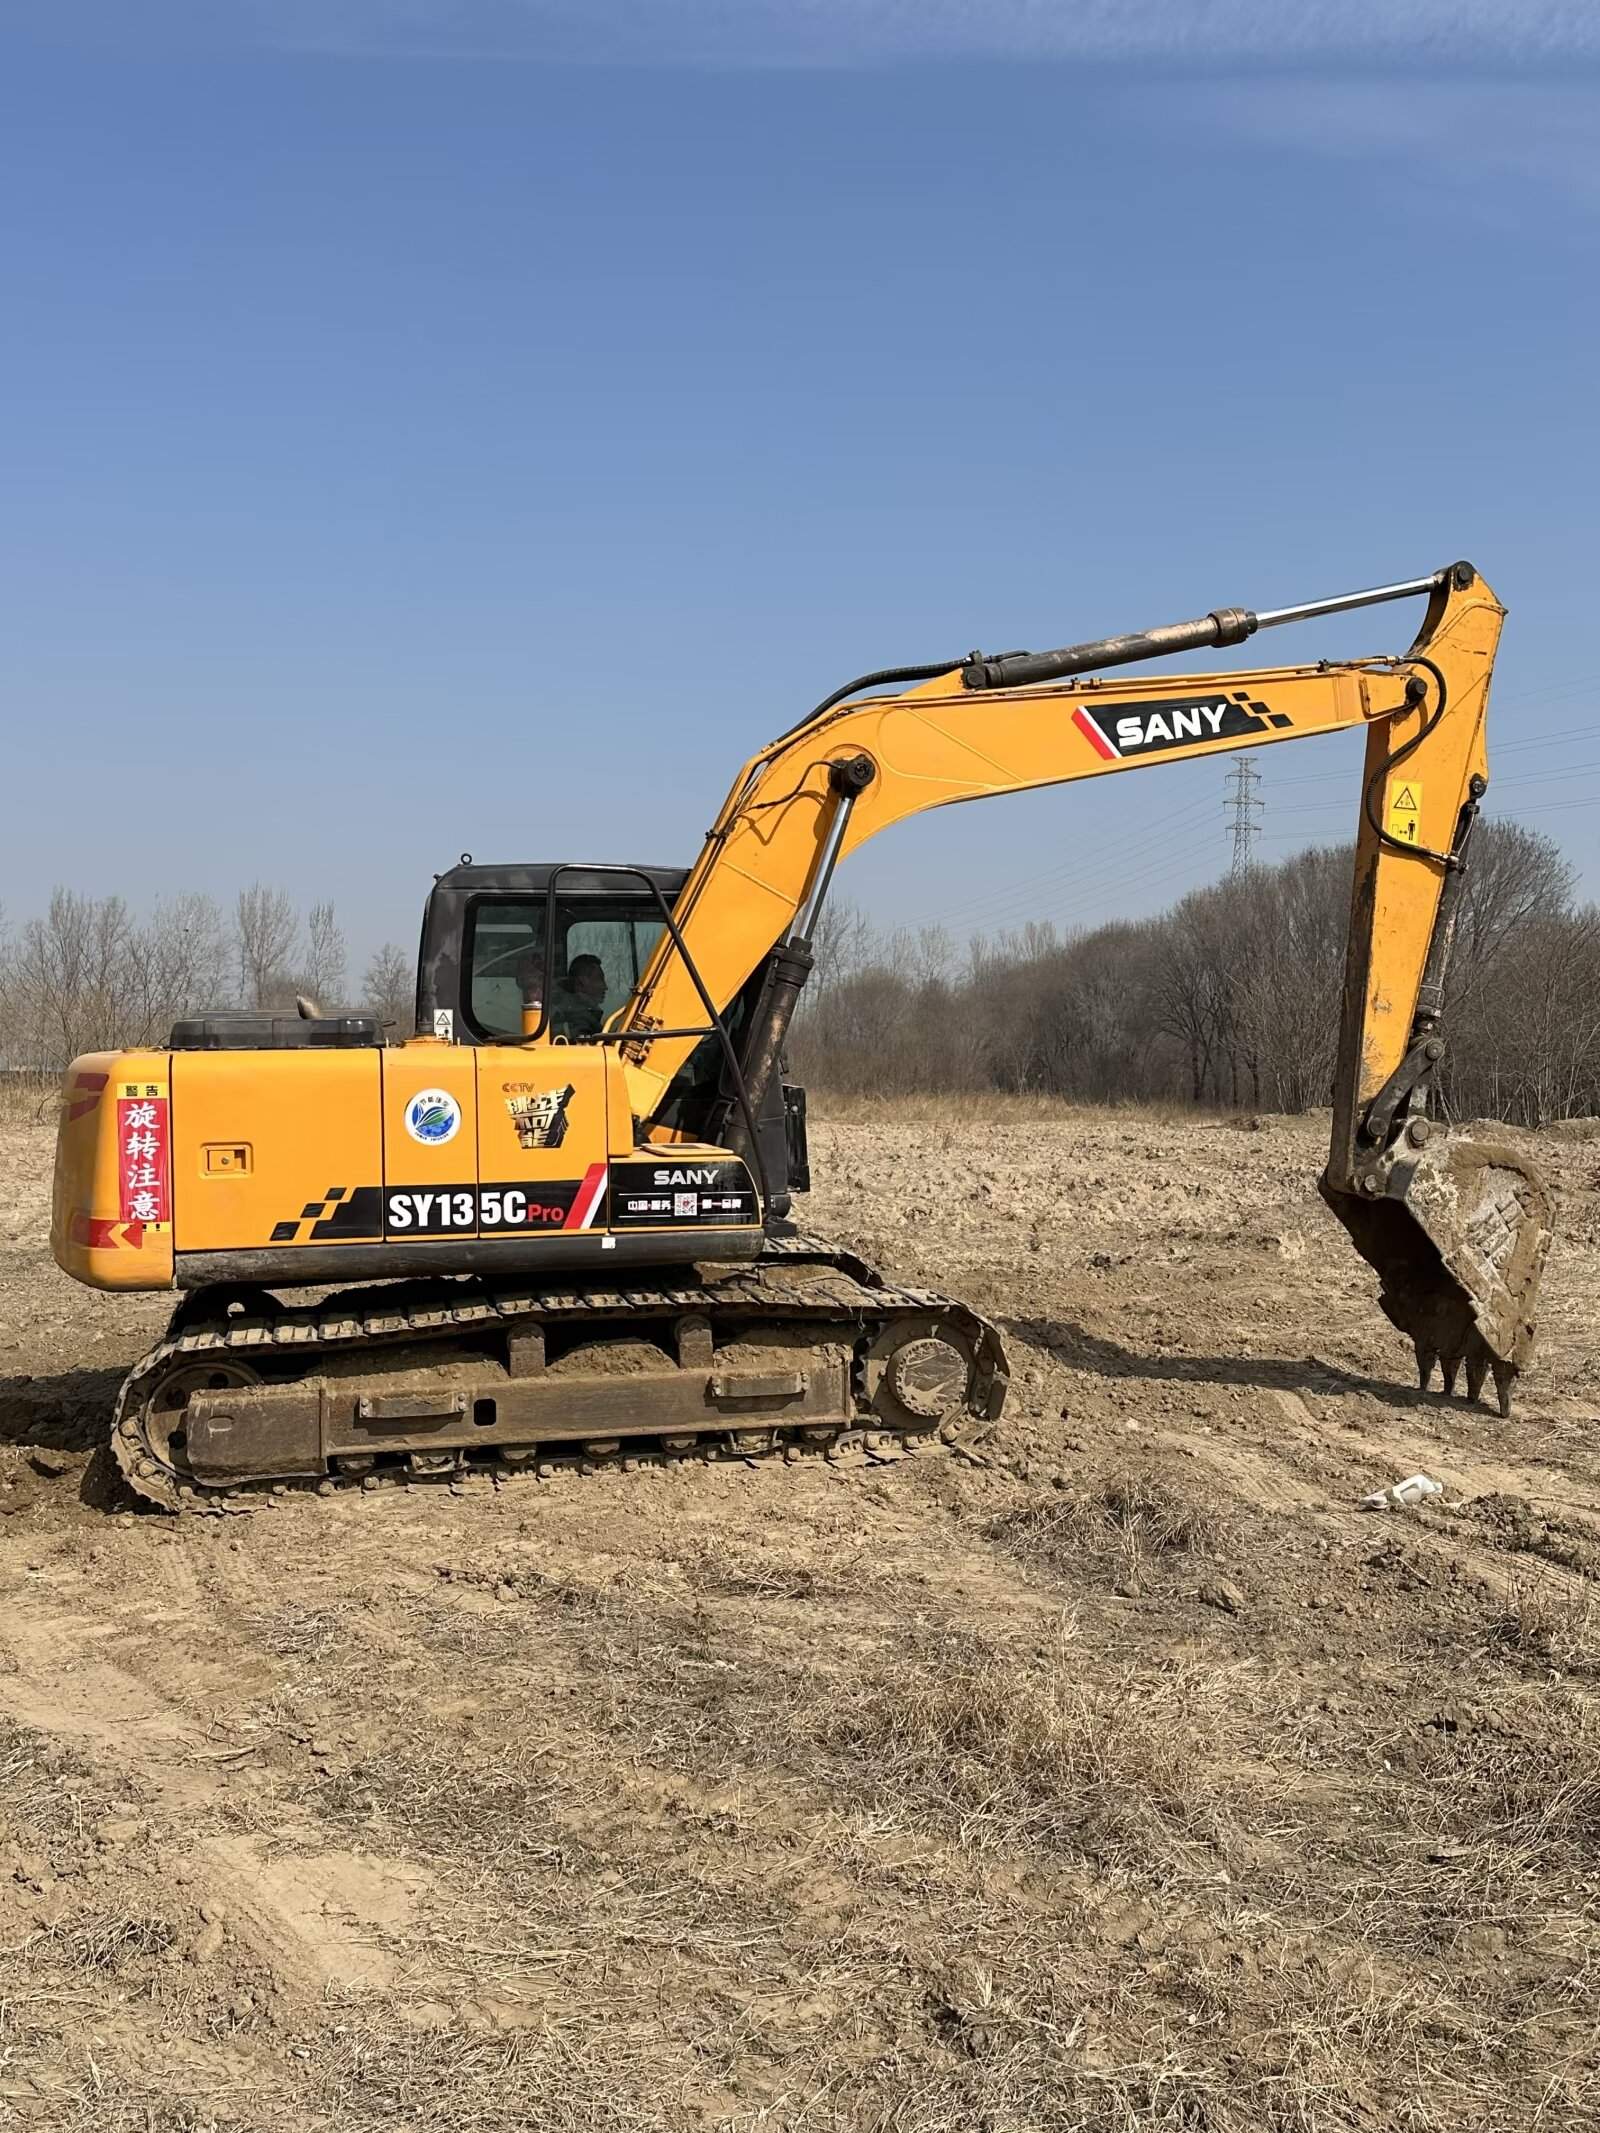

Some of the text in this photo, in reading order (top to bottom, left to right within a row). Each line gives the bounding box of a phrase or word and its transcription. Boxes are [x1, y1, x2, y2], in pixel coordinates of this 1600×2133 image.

[1116, 703, 1227, 747] SANY
[126, 1085, 158, 1096] 警告
[502, 1083, 535, 1092] CCTV
[505, 1088, 564, 1114] 挑战
[511, 1109, 558, 1129] 不可
[520, 1129, 550, 1147] 能
[124, 1102, 160, 1220] 旋转注意
[653, 1169, 719, 1185] SANY
[388, 1190, 564, 1228] SY135C Pro
